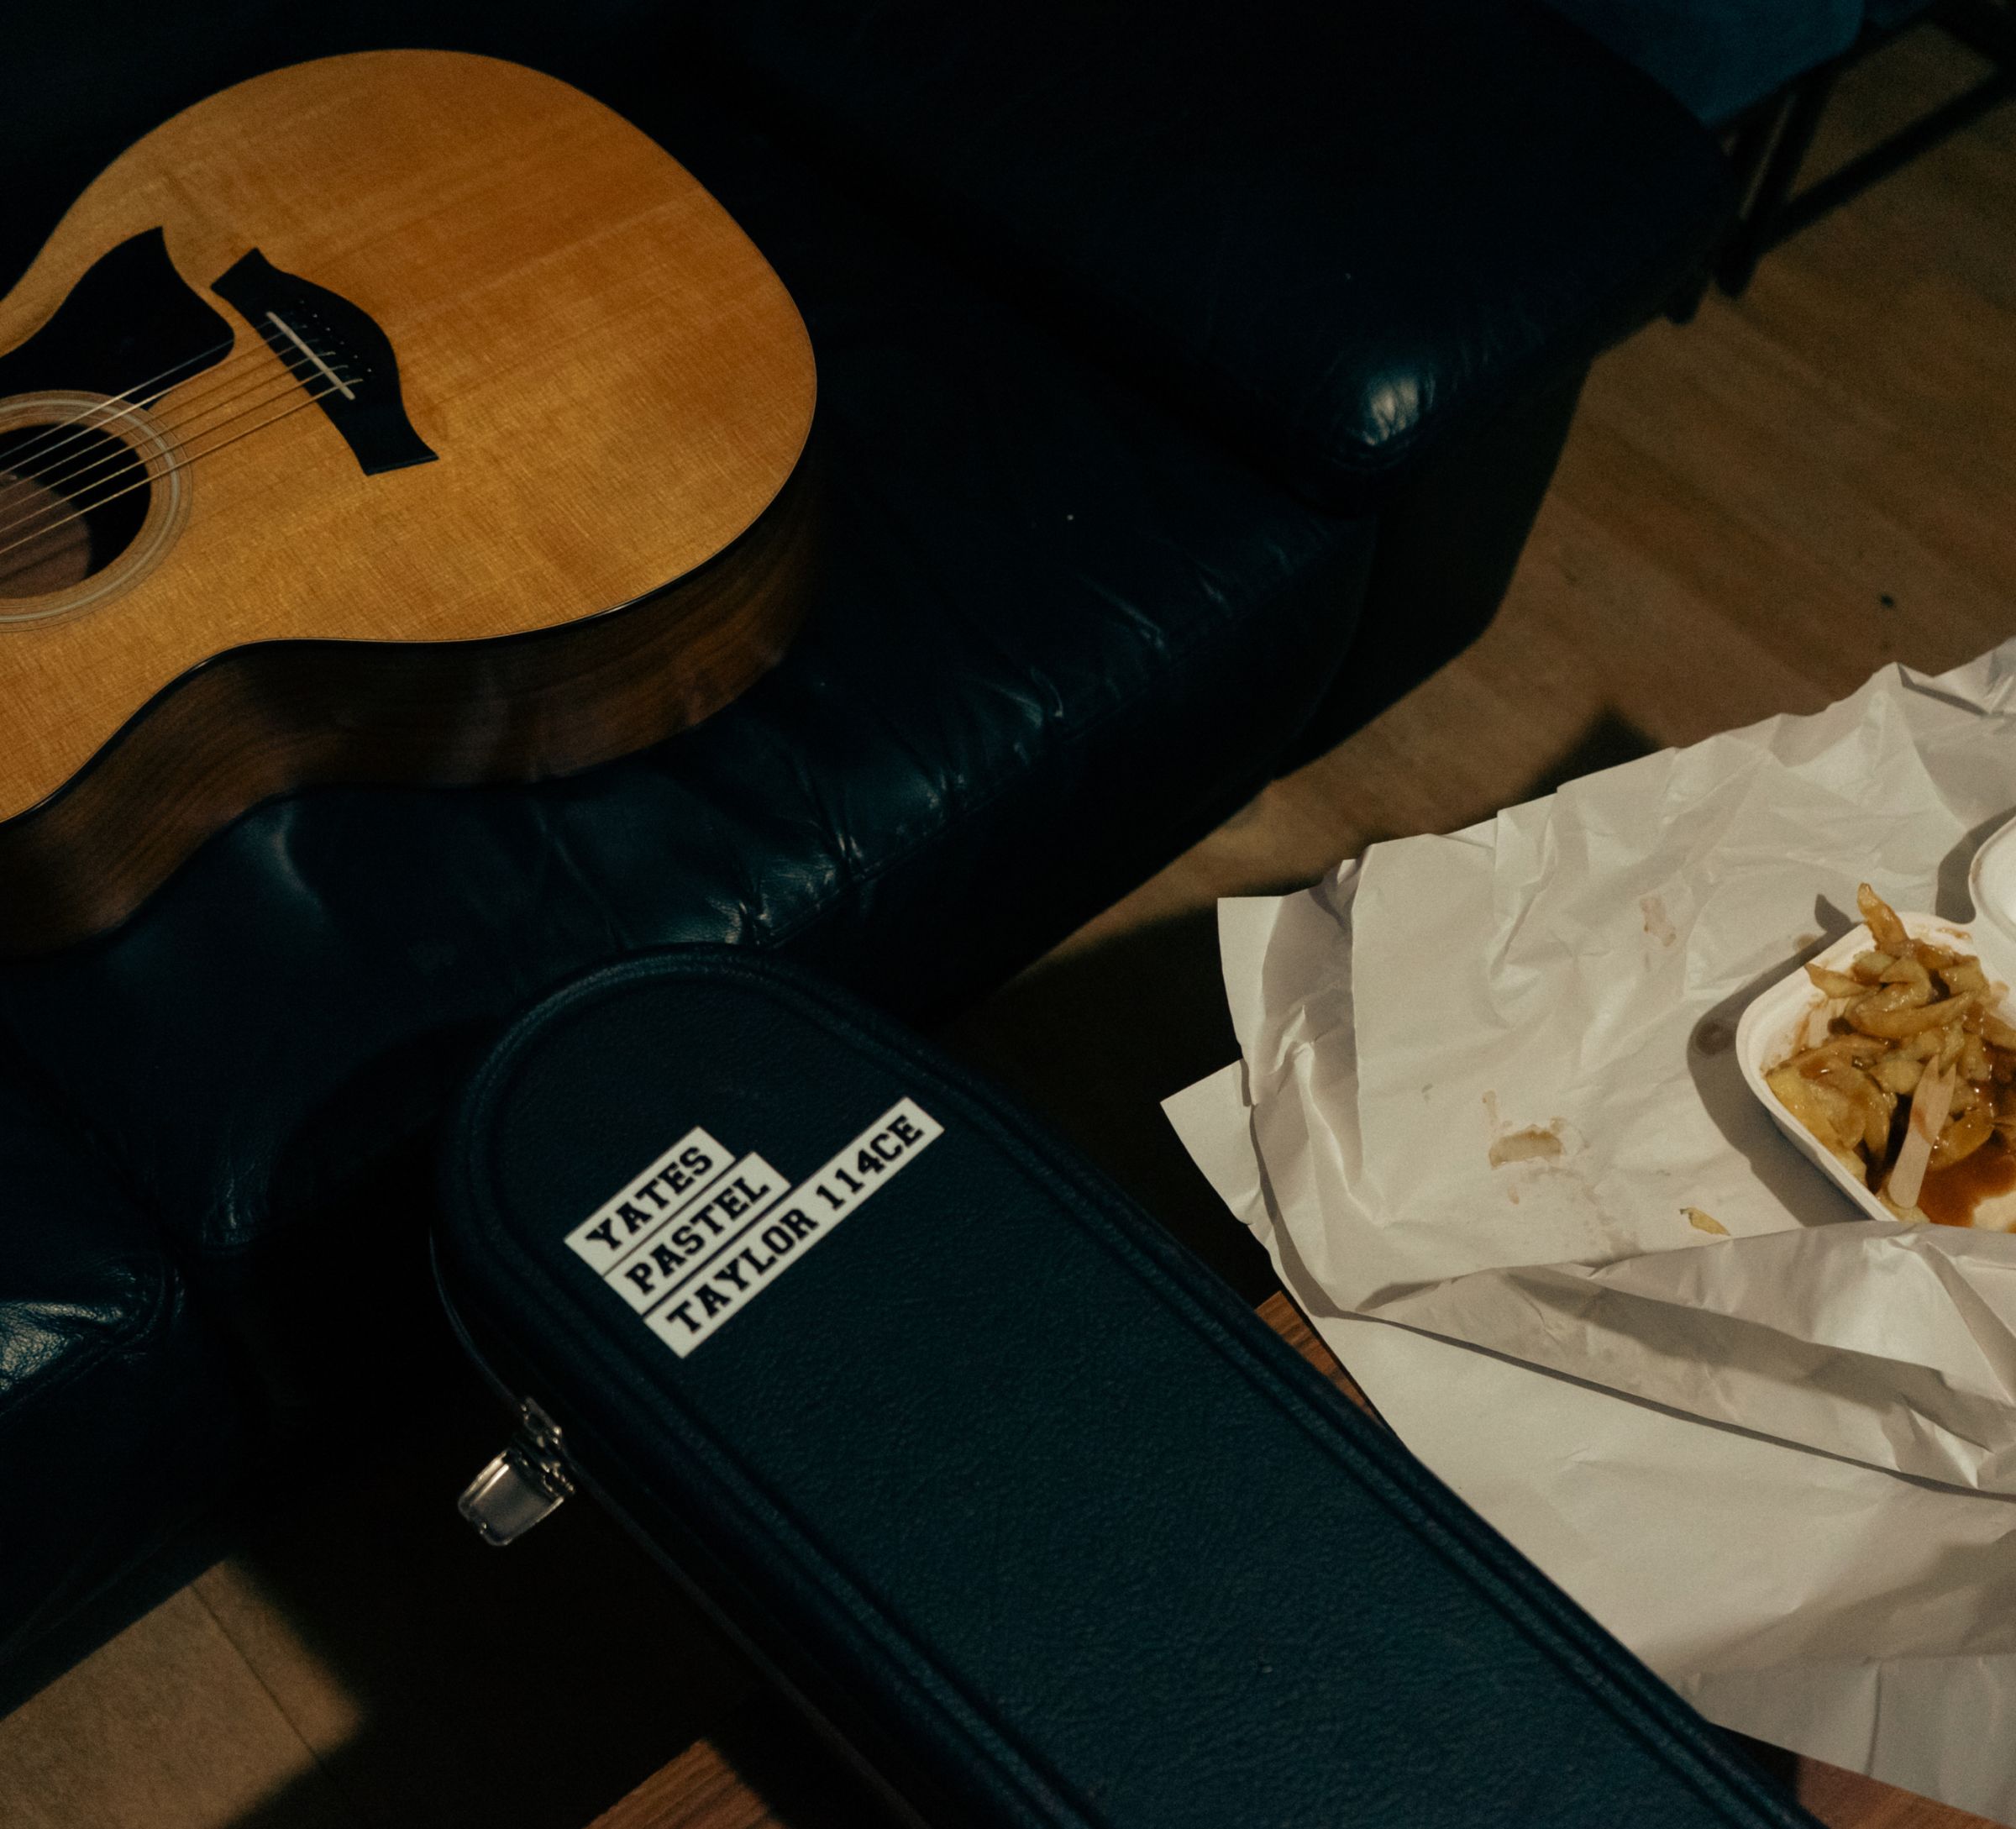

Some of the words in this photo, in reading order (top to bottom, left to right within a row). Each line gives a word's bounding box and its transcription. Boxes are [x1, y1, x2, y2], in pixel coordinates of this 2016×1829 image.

[585, 1146, 713, 1252] YATES
[624, 1177, 770, 1296] PASTEL
[665, 1208, 819, 1335] TAYLOR
[816, 1115, 925, 1211] 114CE
